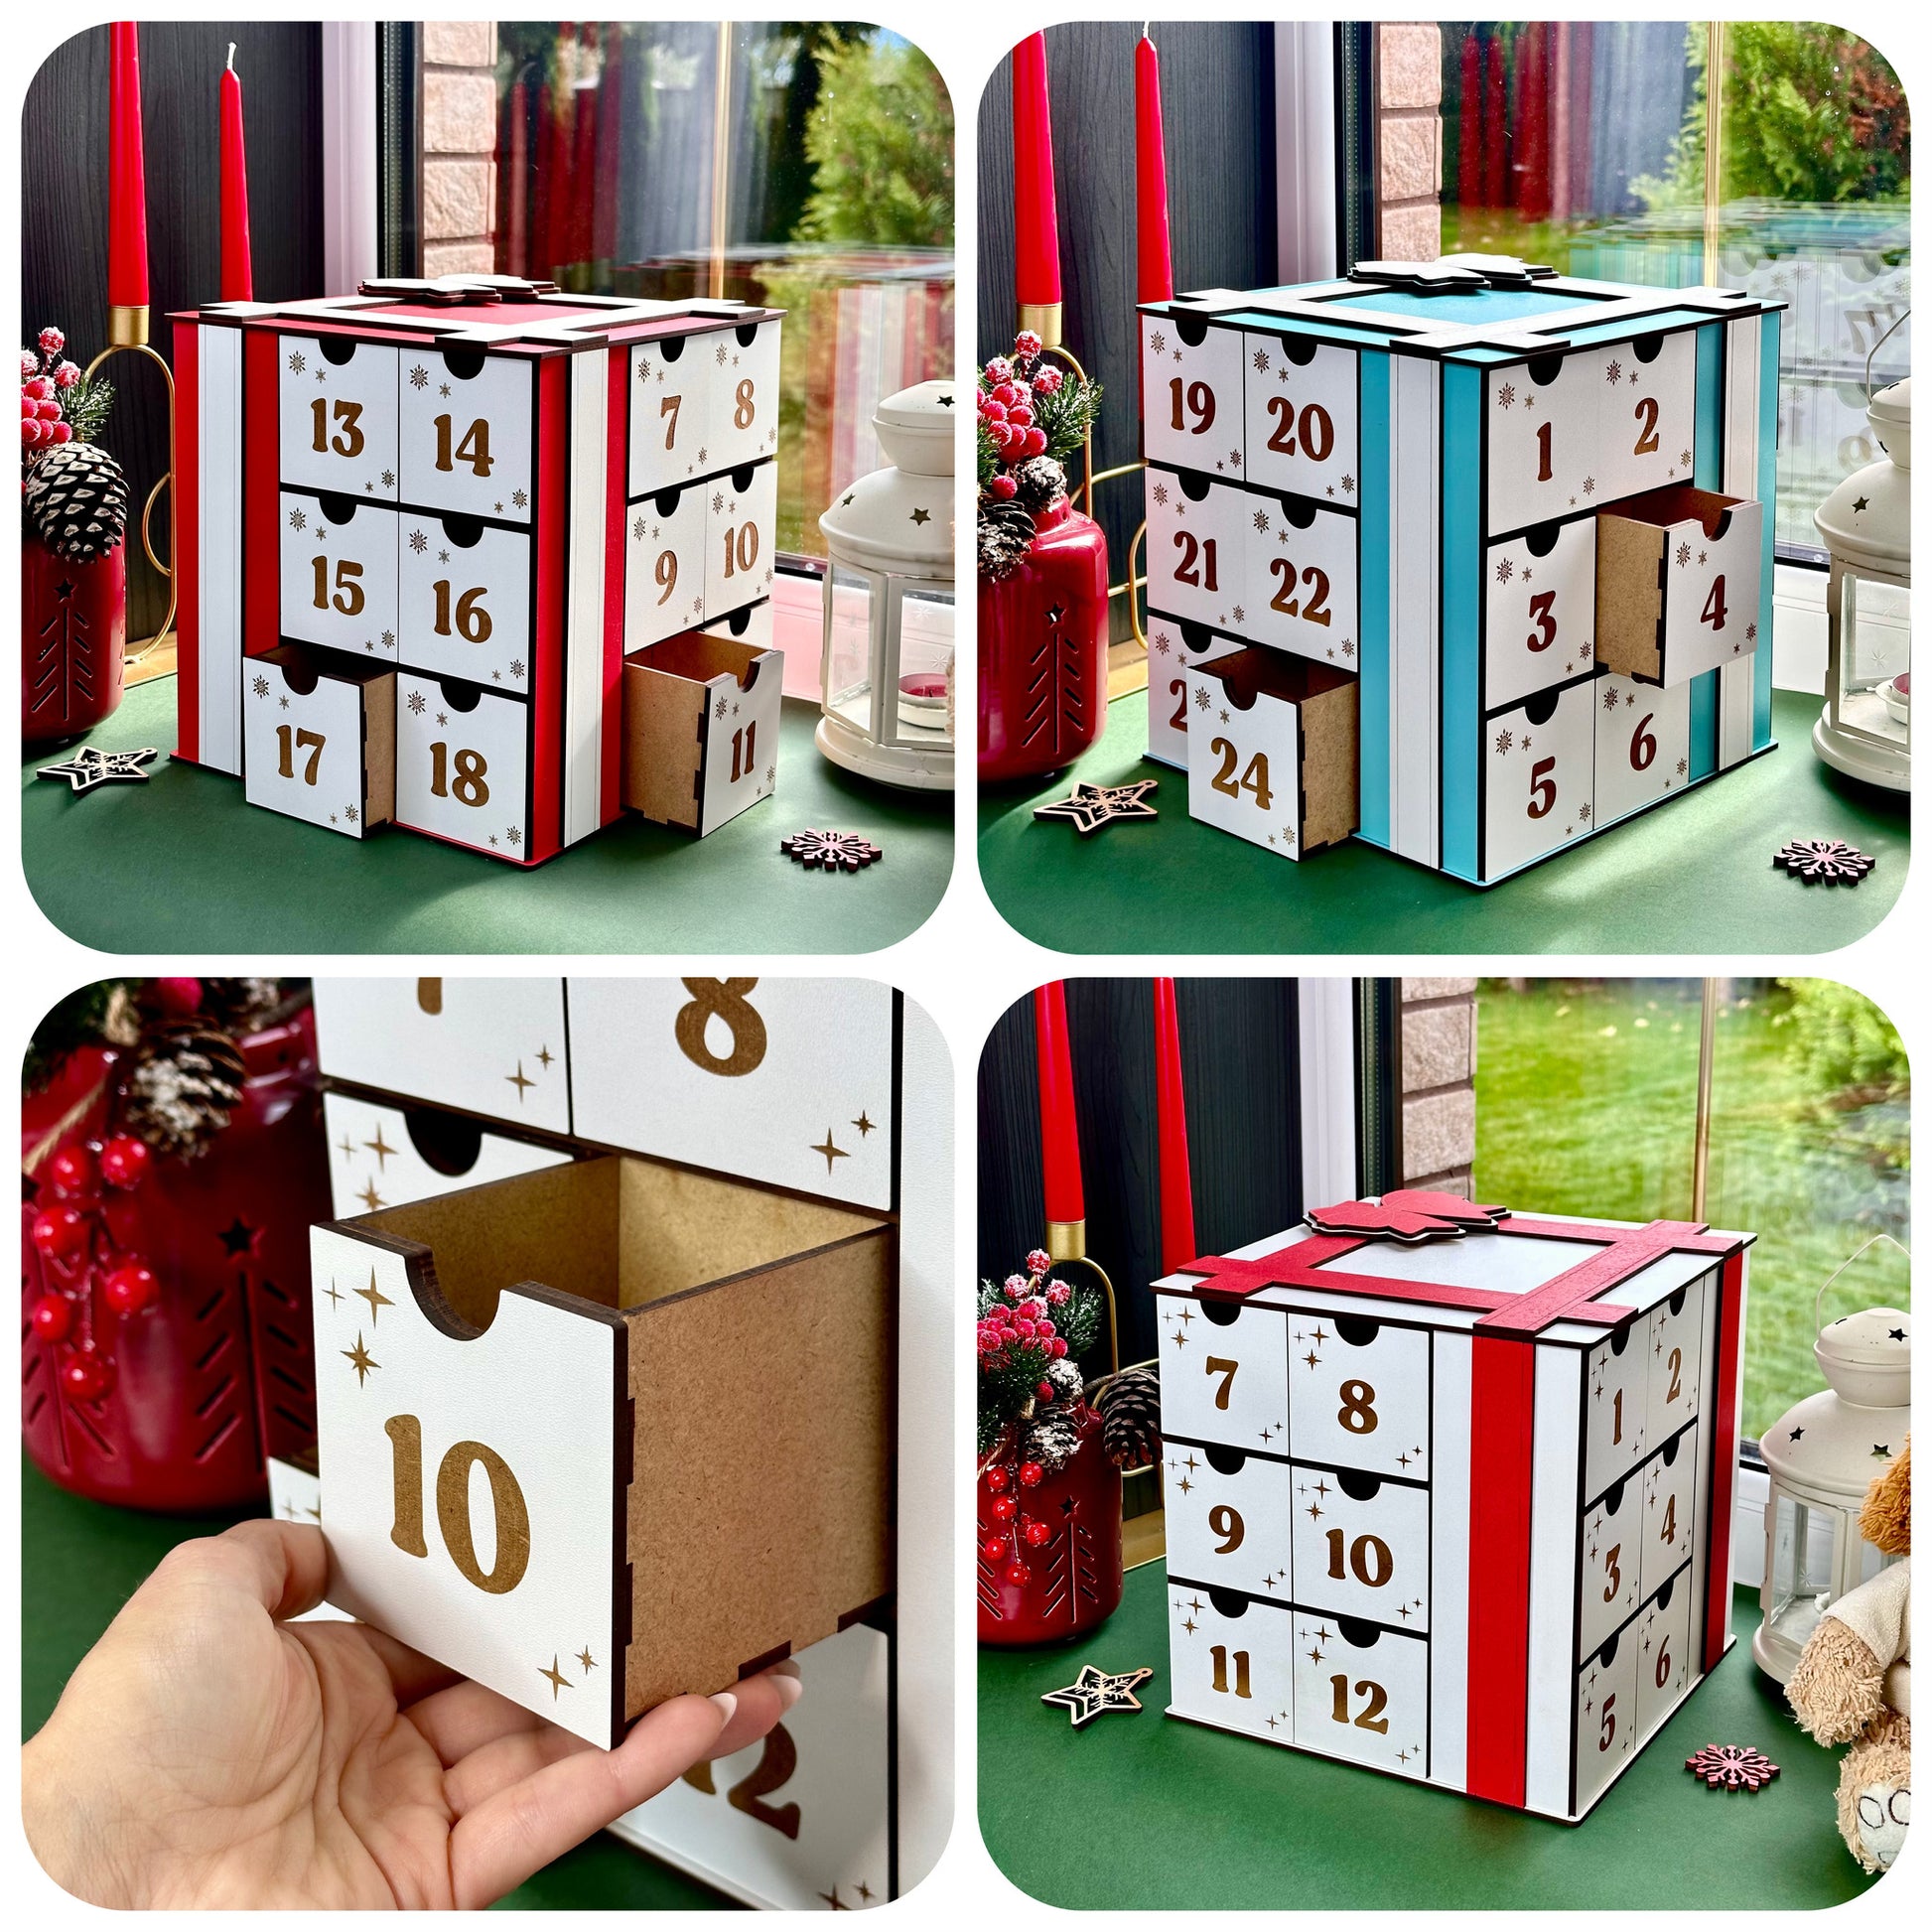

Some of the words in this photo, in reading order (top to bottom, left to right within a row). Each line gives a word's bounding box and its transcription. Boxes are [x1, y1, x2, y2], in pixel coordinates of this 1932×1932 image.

[311, 398, 364, 458] 13
[660, 395, 681, 450] 7
[734, 379, 755, 429] 8
[1170, 377, 1215, 434] 19
[1268, 397, 1333, 462] 20
[1634, 398, 1659, 455] 2
[434, 414, 494, 477] 14
[1537, 422, 1552, 482] 1
[655, 550, 677, 606] 9
[724, 521, 759, 578] 10
[1173, 531, 1218, 592] 21
[312, 556, 364, 616] 15
[433, 580, 492, 643] 16
[1270, 558, 1330, 626] 22
[1701, 575, 1727, 630] 4
[1527, 591, 1557, 652] 3
[276, 725, 326, 785] 17
[731, 721, 756, 782] 11
[1630, 713, 1656, 770] 6
[430, 742, 489, 807] 18
[1211, 738, 1273, 810] 24
[1528, 757, 1556, 819] 5
[675, 977, 766, 1076] 8
[1206, 1356, 1238, 1410] 7
[1667, 1348, 1681, 1404] 2
[1338, 1380, 1378, 1434] 8
[1613, 1388, 1622, 1446] 1
[384, 1414, 530, 1594] 10
[1209, 1505, 1244, 1554] 9
[1661, 1494, 1676, 1545] 4
[1325, 1529, 1393, 1587] 10
[1603, 1544, 1620, 1602] 3
[1210, 1645, 1252, 1699] 11
[1656, 1634, 1670, 1688] 6
[1330, 1675, 1389, 1734] 12
[1599, 1693, 1615, 1751] 5
[679, 1721, 801, 1842] 2
